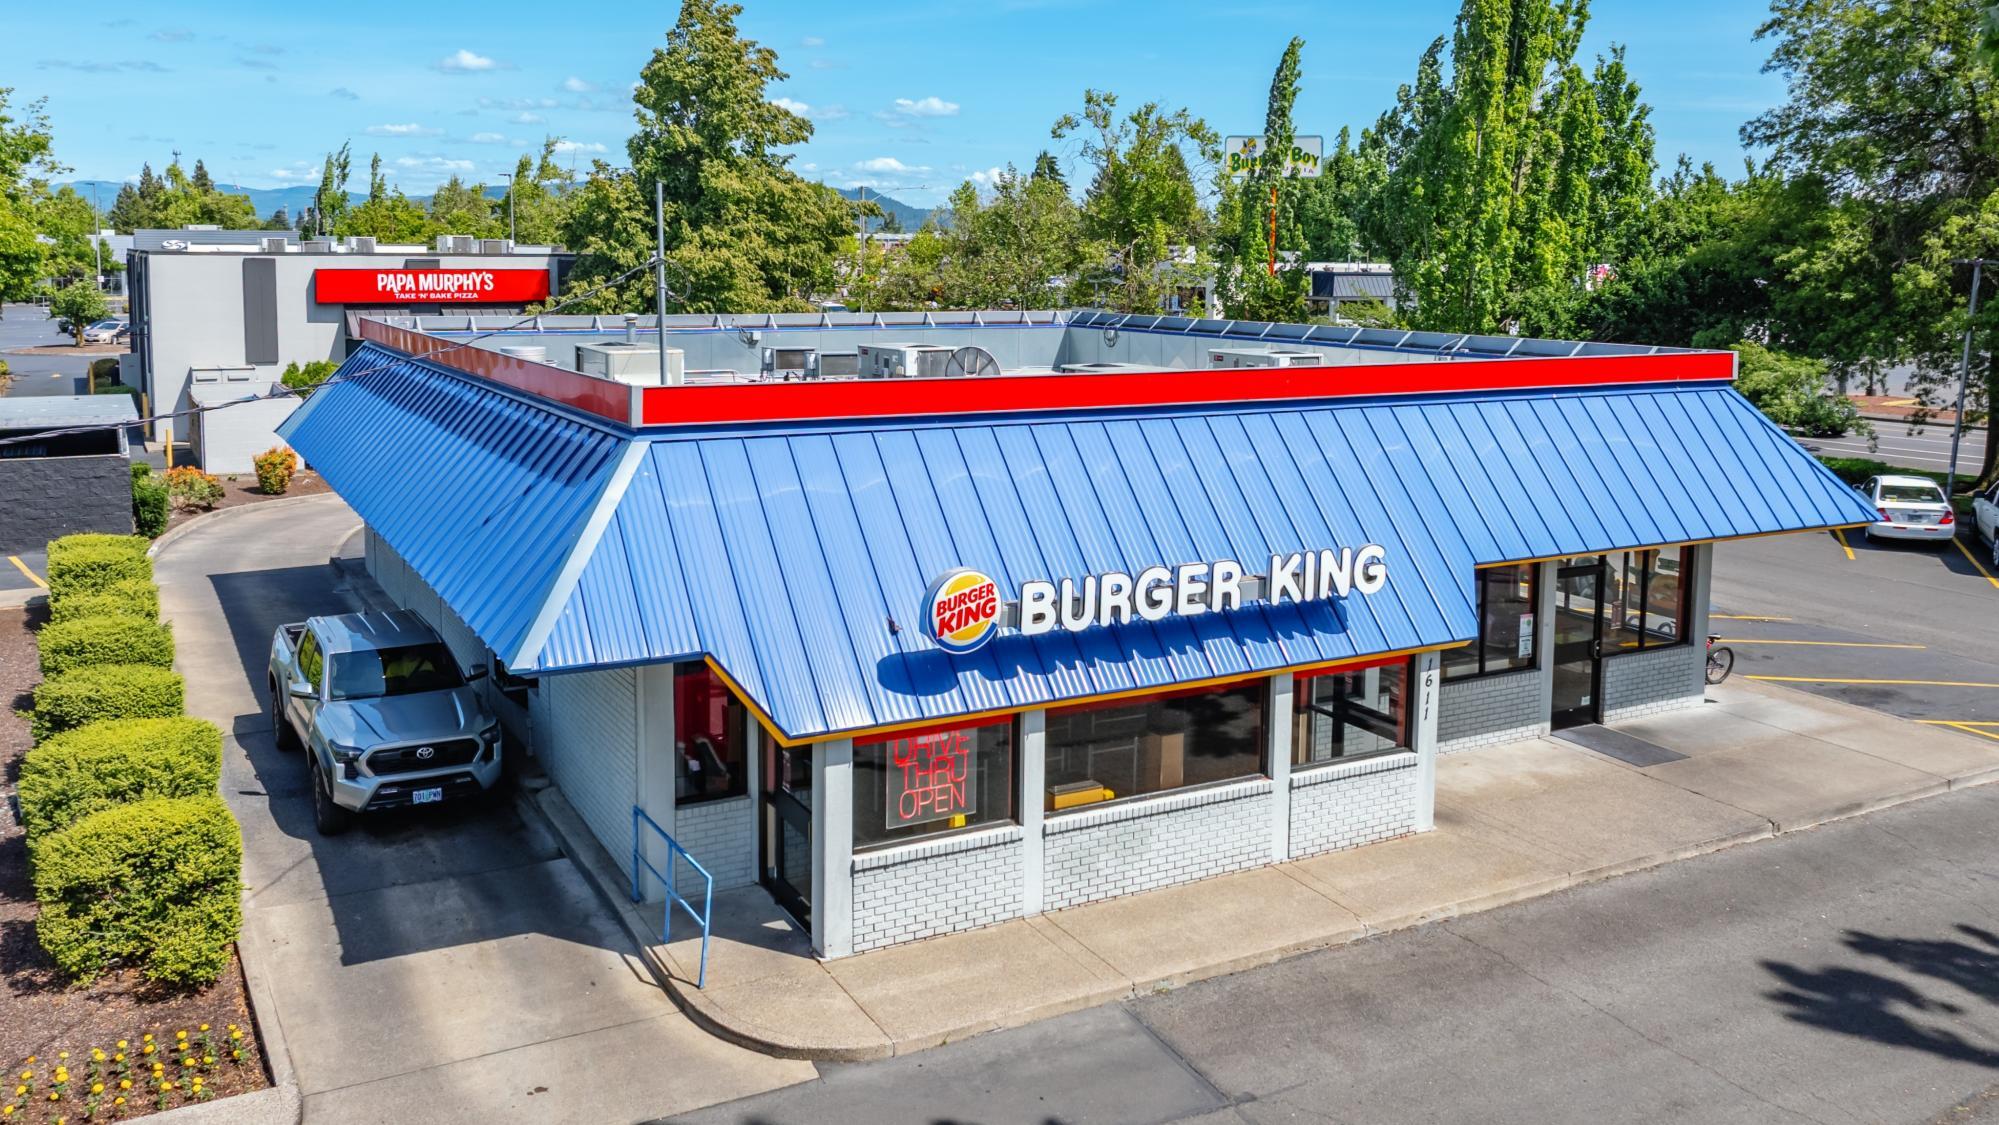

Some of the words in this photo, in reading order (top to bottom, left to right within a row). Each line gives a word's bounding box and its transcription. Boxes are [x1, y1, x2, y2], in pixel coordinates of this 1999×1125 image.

[377, 273, 416, 293] PAPA
[418, 271, 494, 292] MURPHY'S
[936, 583, 995, 617] BURGER
[1020, 559, 1243, 636] BURGER
[1270, 543, 1387, 607] KING
[937, 597, 997, 638] KING
[1423, 657, 1433, 721] 1611
[897, 751, 967, 791] THRU
[899, 783, 965, 819] OPEN
